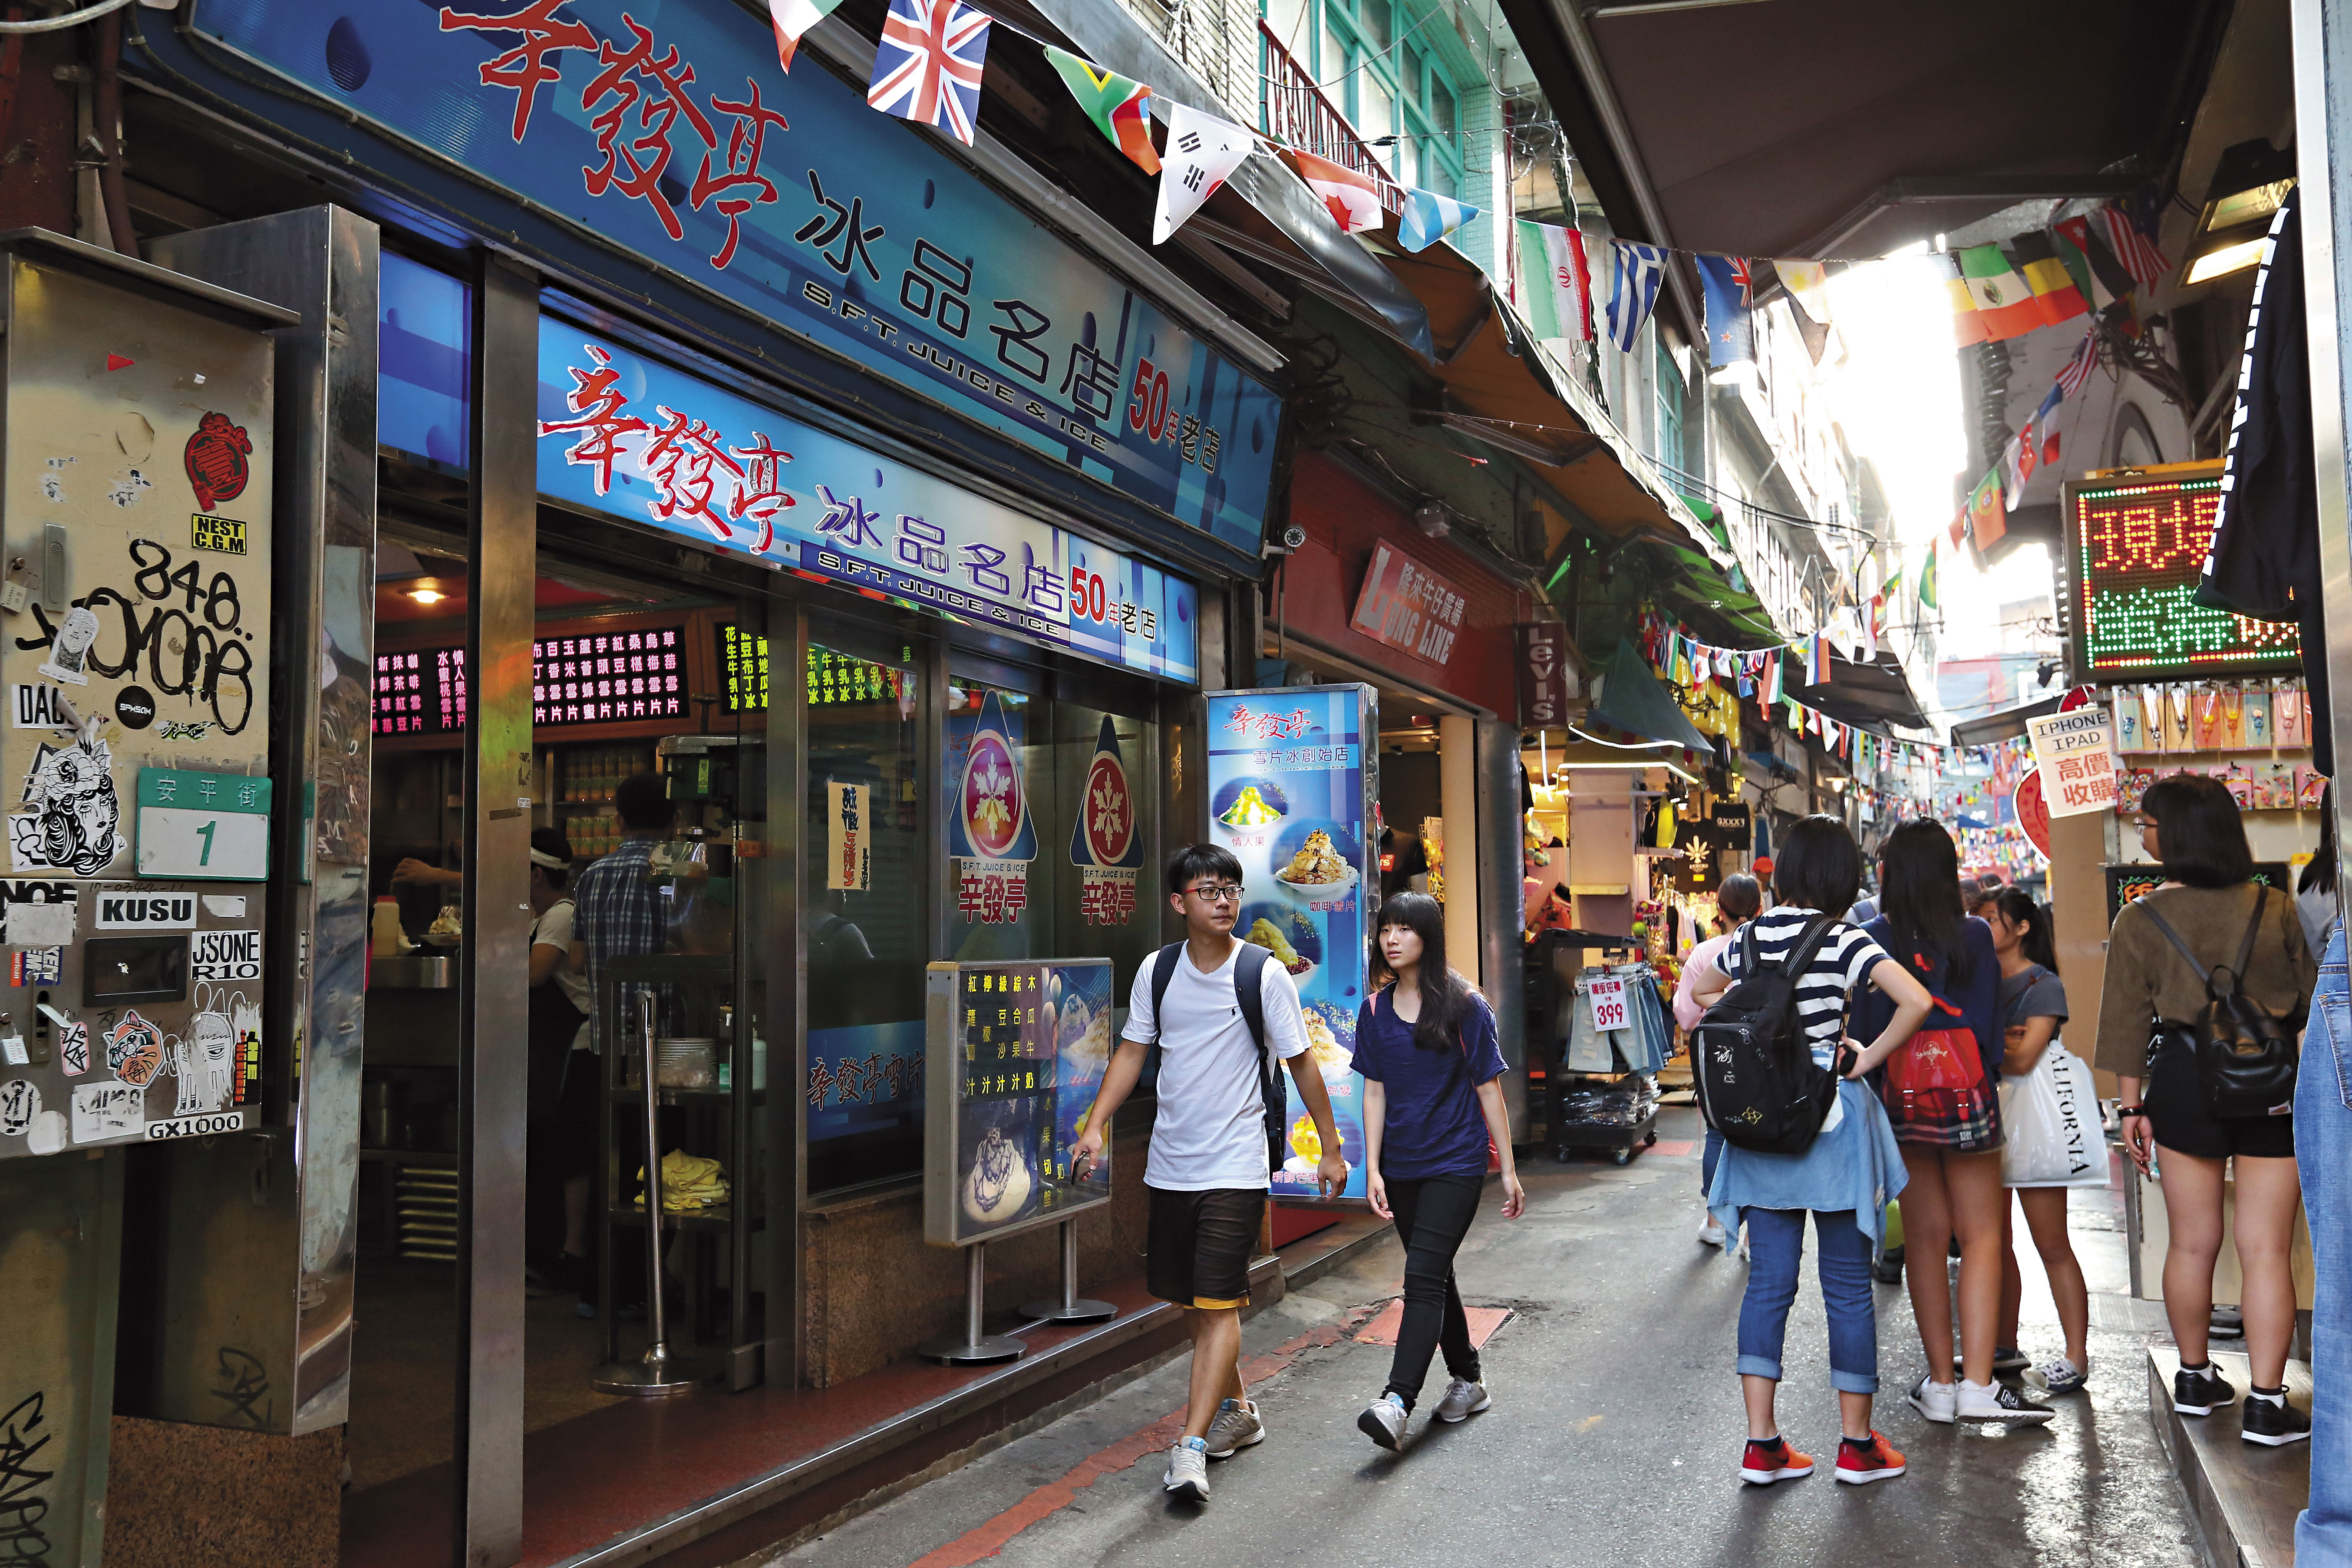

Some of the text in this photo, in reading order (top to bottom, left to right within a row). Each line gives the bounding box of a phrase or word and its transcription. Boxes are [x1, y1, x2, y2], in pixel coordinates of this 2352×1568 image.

[794, 169, 1121, 422] 冰品名店
[907, 343, 1015, 404] JUICE
[1025, 401, 1047, 423] &
[1059, 416, 1108, 452] ICE
[1129, 356, 1220, 472] 50年老店
[537, 344, 797, 555] 辛發亭
[194, 535, 245, 554] C.G.M
[198, 518, 241, 538] NEST
[814, 484, 1065, 615] 冰品名店
[898, 578, 983, 613] JUICE
[992, 607, 1010, 623] &
[1019, 613, 1060, 637] ICE
[1070, 564, 1156, 643] 50年老店
[1417, 619, 1456, 665] LINE
[547, 641, 562, 722] 百香雪片
[563, 640, 578, 720] 玉米雪片
[596, 637, 611, 718] 芋頭雪片
[612, 636, 628, 717] 紅豆雪片
[663, 631, 679, 714] 草莓雪片
[1224, 704, 1311, 739] 辛發亭
[2036, 712, 2109, 737] IPHONE
[2053, 731, 2101, 751] IPAD
[1254, 746, 1349, 764] 雪片冰創始店
[2055, 752, 2112, 782] 高價
[157, 776, 257, 808] 安平街
[2063, 778, 2118, 807] 收購
[196, 819, 216, 865] 1
[1231, 836, 1265, 848] 情人果
[983, 862, 1005, 871] JUICE
[1101, 870, 1118, 878] JUICE
[102, 899, 192, 921] KUSU
[958, 874, 1027, 924] 辛發亭
[1081, 881, 1136, 925] 辛發亭
[1310, 900, 1356, 912] 咖啡雪片
[1597, 1003, 1623, 1025] 399
[149, 1114, 240, 1139] GX1000
[2046, 1042, 2091, 1175] ALIFORNIA
[1272, 1171, 1319, 1185] 新鮮芒果
